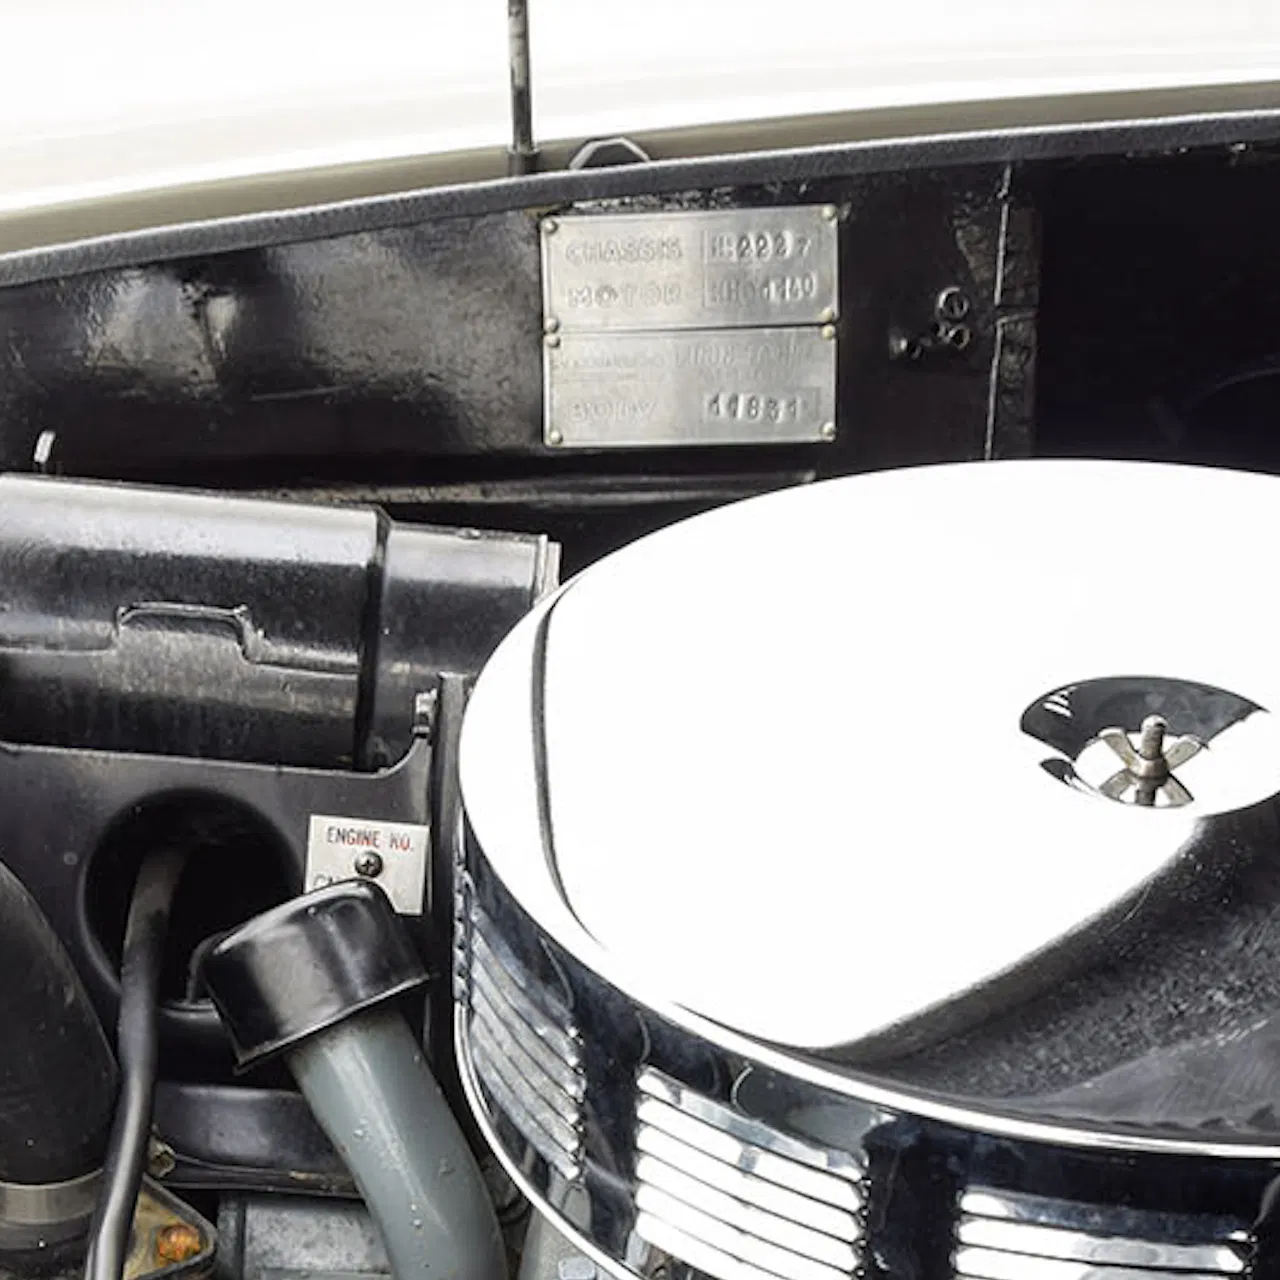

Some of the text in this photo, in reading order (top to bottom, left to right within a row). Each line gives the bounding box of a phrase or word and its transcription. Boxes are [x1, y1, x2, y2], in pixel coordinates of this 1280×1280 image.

[565, 235, 683, 266] CHASSIS
[567, 281, 682, 309] MOTOR
[326, 825, 382, 848] ENGINE
